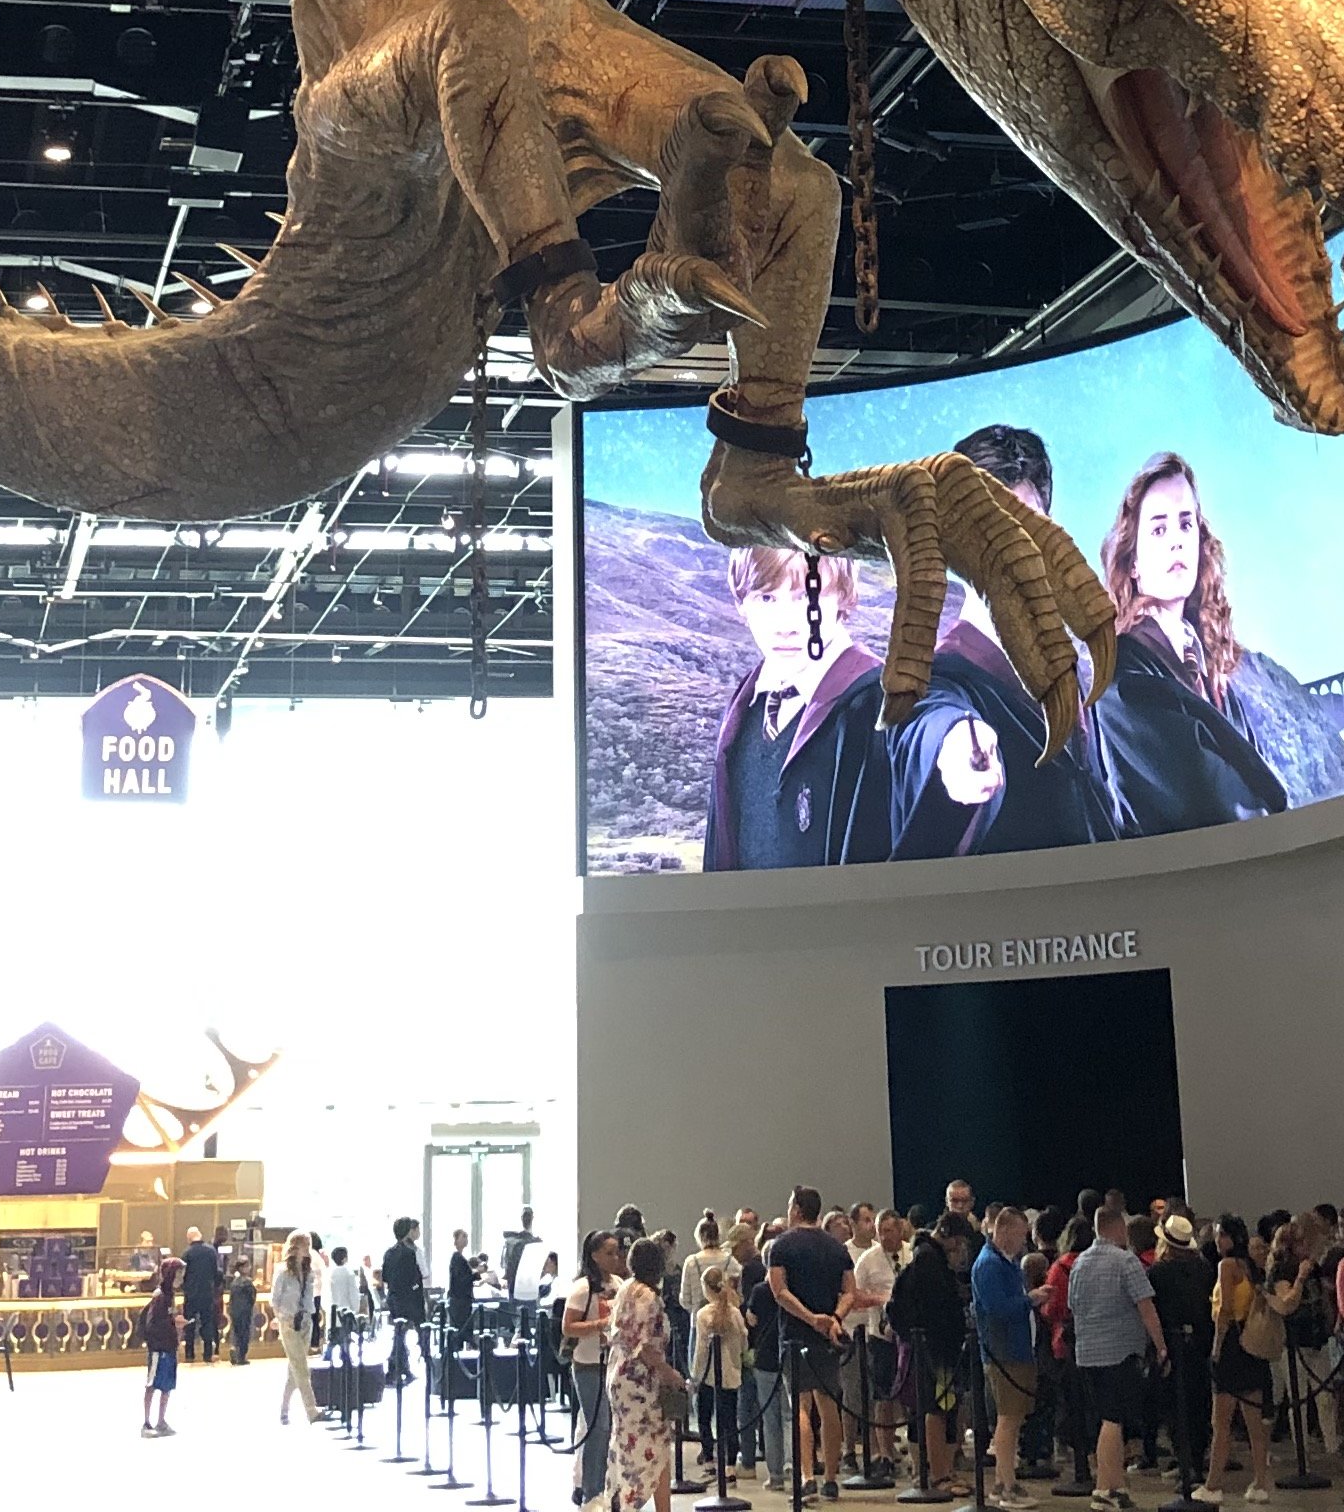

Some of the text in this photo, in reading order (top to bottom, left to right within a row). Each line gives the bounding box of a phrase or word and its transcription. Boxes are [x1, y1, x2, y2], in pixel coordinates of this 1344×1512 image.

[101, 735, 175, 762] FOOD
[103, 768, 172, 794] HALL
[914, 930, 1138, 972] TOUR ENTRANCE
[51, 1088, 113, 1097] HOT CHOCOLATE
[77, 1109, 106, 1118] TREATS
[19, 1147, 67, 1157] HOT DRINKS
